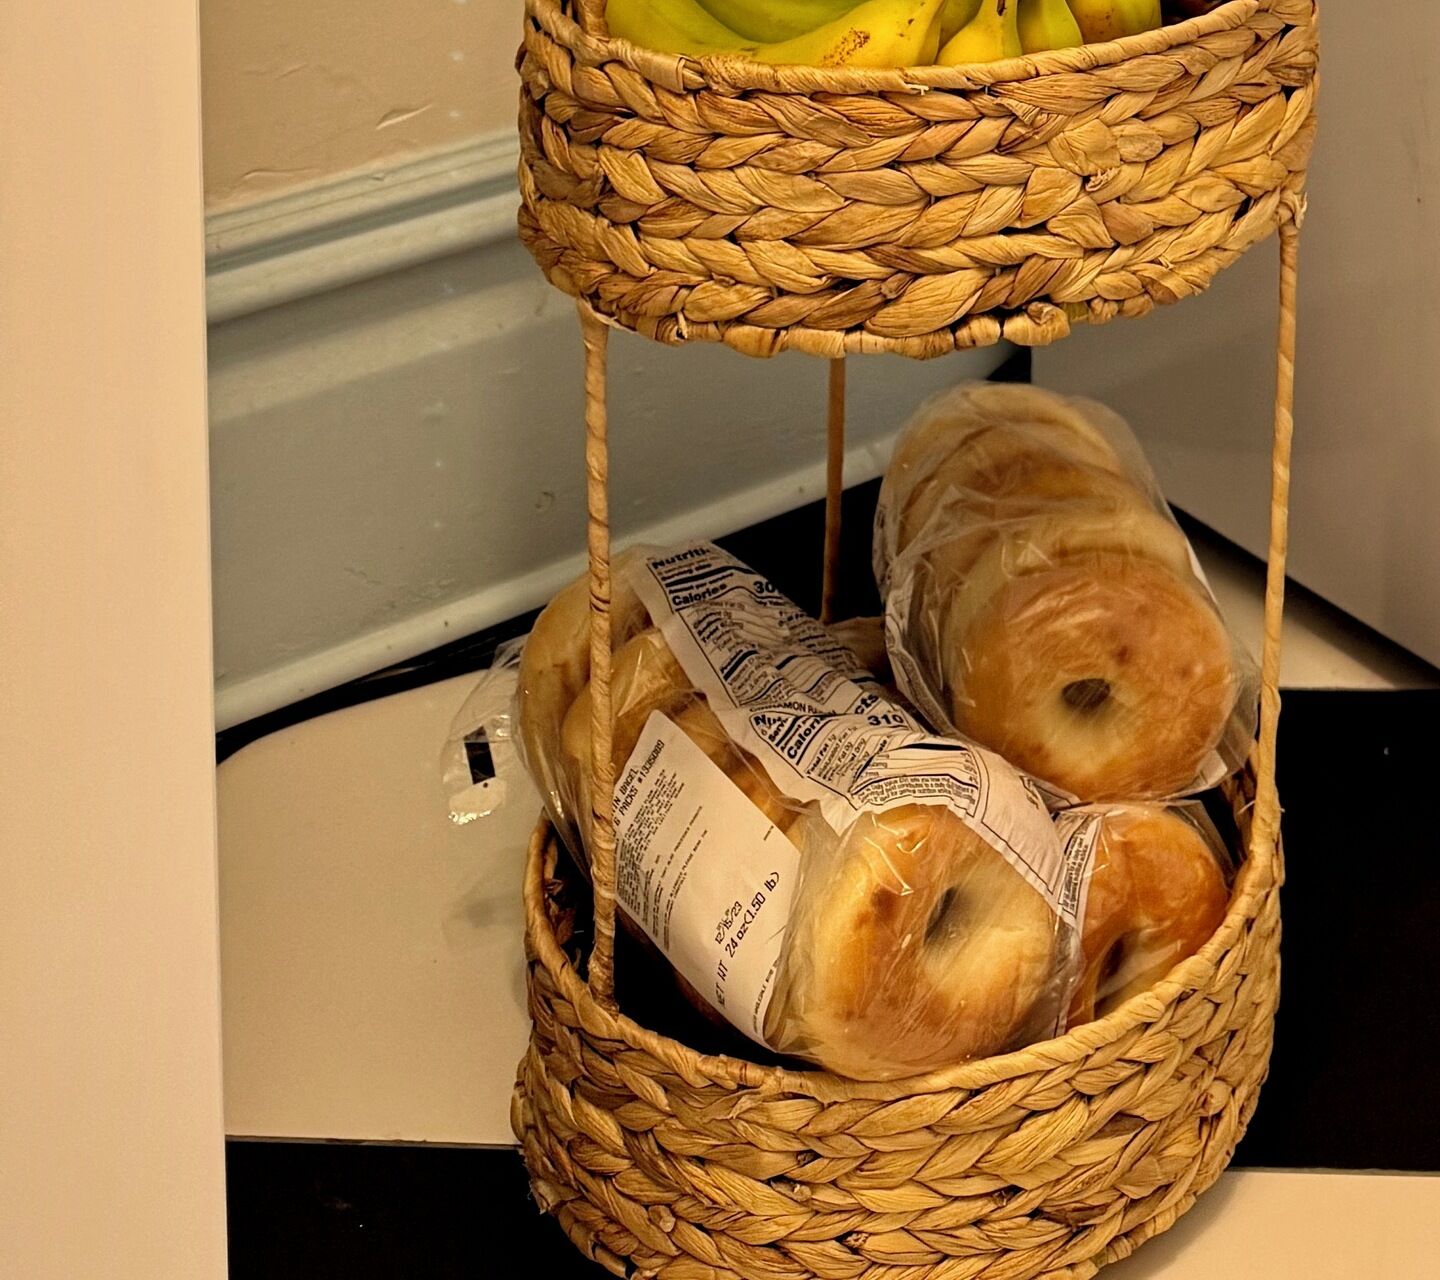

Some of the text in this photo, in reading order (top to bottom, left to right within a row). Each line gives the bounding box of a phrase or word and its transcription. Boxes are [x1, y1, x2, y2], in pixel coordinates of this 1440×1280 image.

[671, 583, 728, 606] Calories
[867, 713, 904, 726] 310
[619, 767, 639, 795] BAGEL
[619, 786, 639, 816] PACKS
[714, 900, 743, 944] 12/15/23
[724, 936, 738, 958] 24
